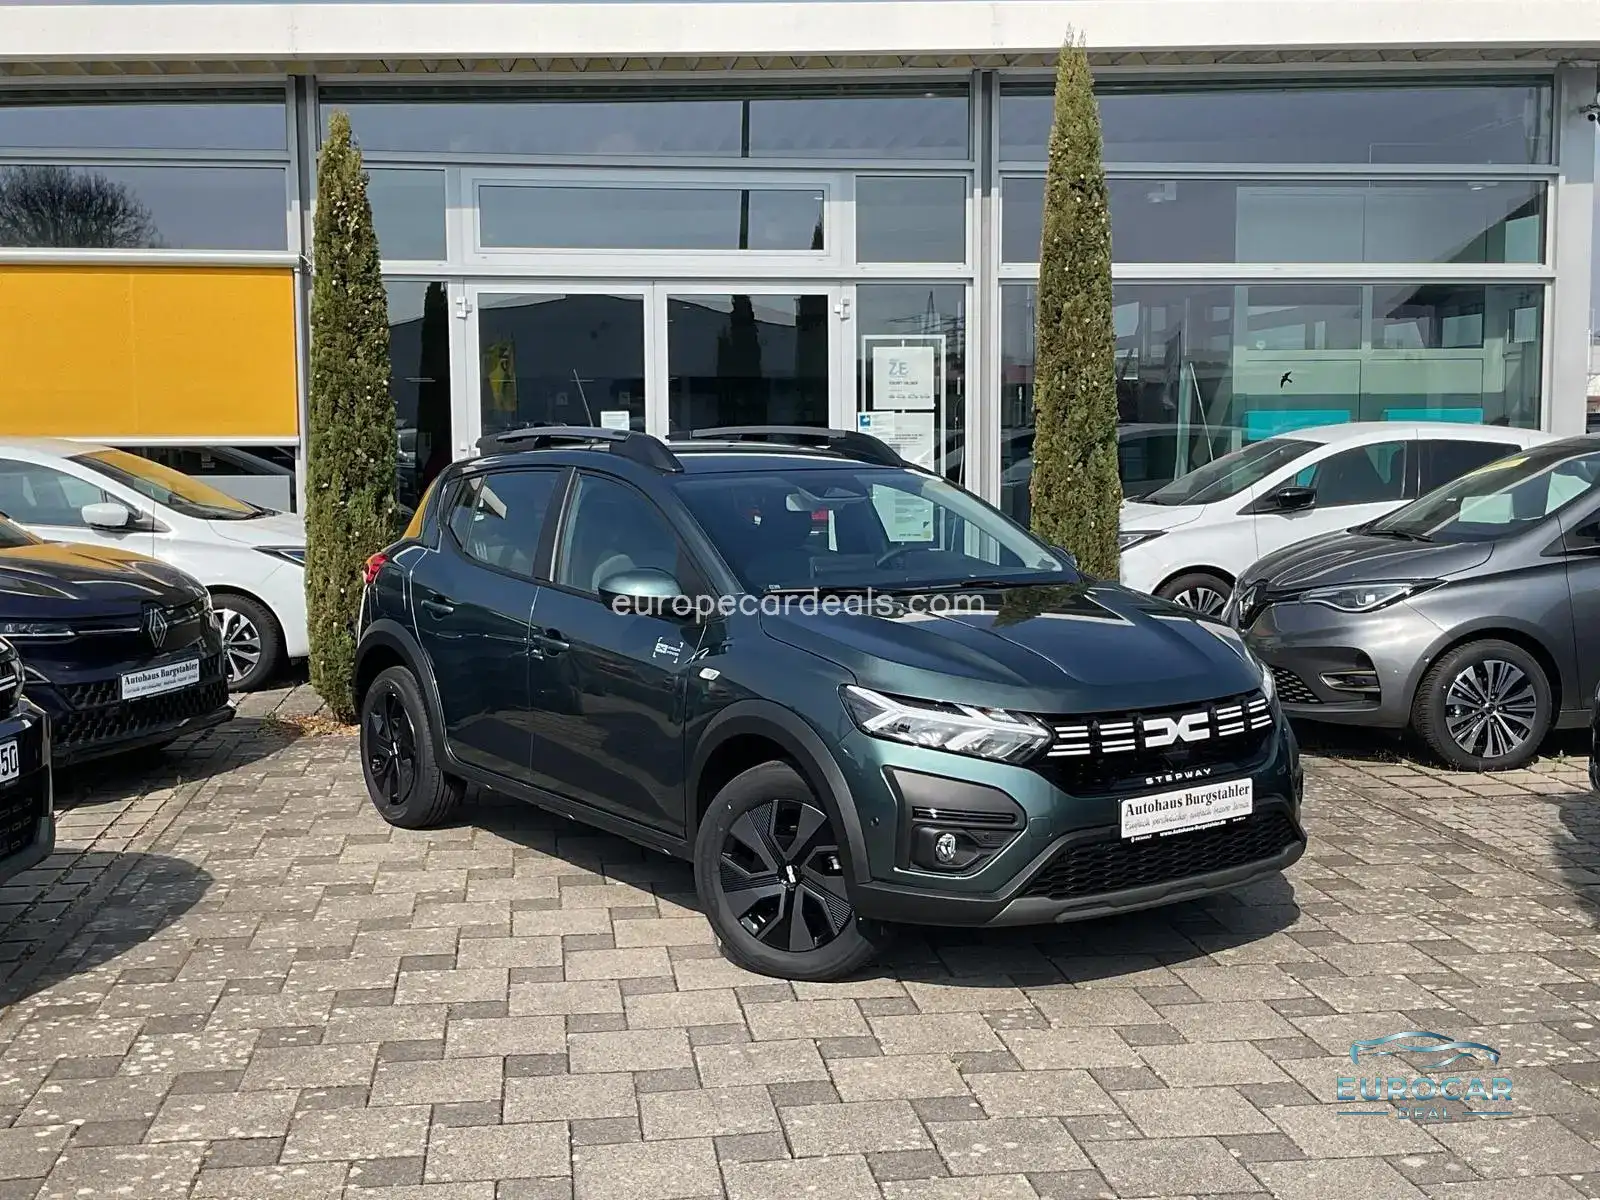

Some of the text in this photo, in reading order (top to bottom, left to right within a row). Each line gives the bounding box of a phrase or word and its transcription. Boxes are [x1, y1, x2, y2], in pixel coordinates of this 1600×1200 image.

[125, 672, 160, 686] Autohaus
[160, 662, 198, 678] Burgstahler
[1145, 768, 1211, 785] STEPWAY
[1125, 799, 1183, 817] Autohaus
[1185, 784, 1250, 806] Burgstahler
